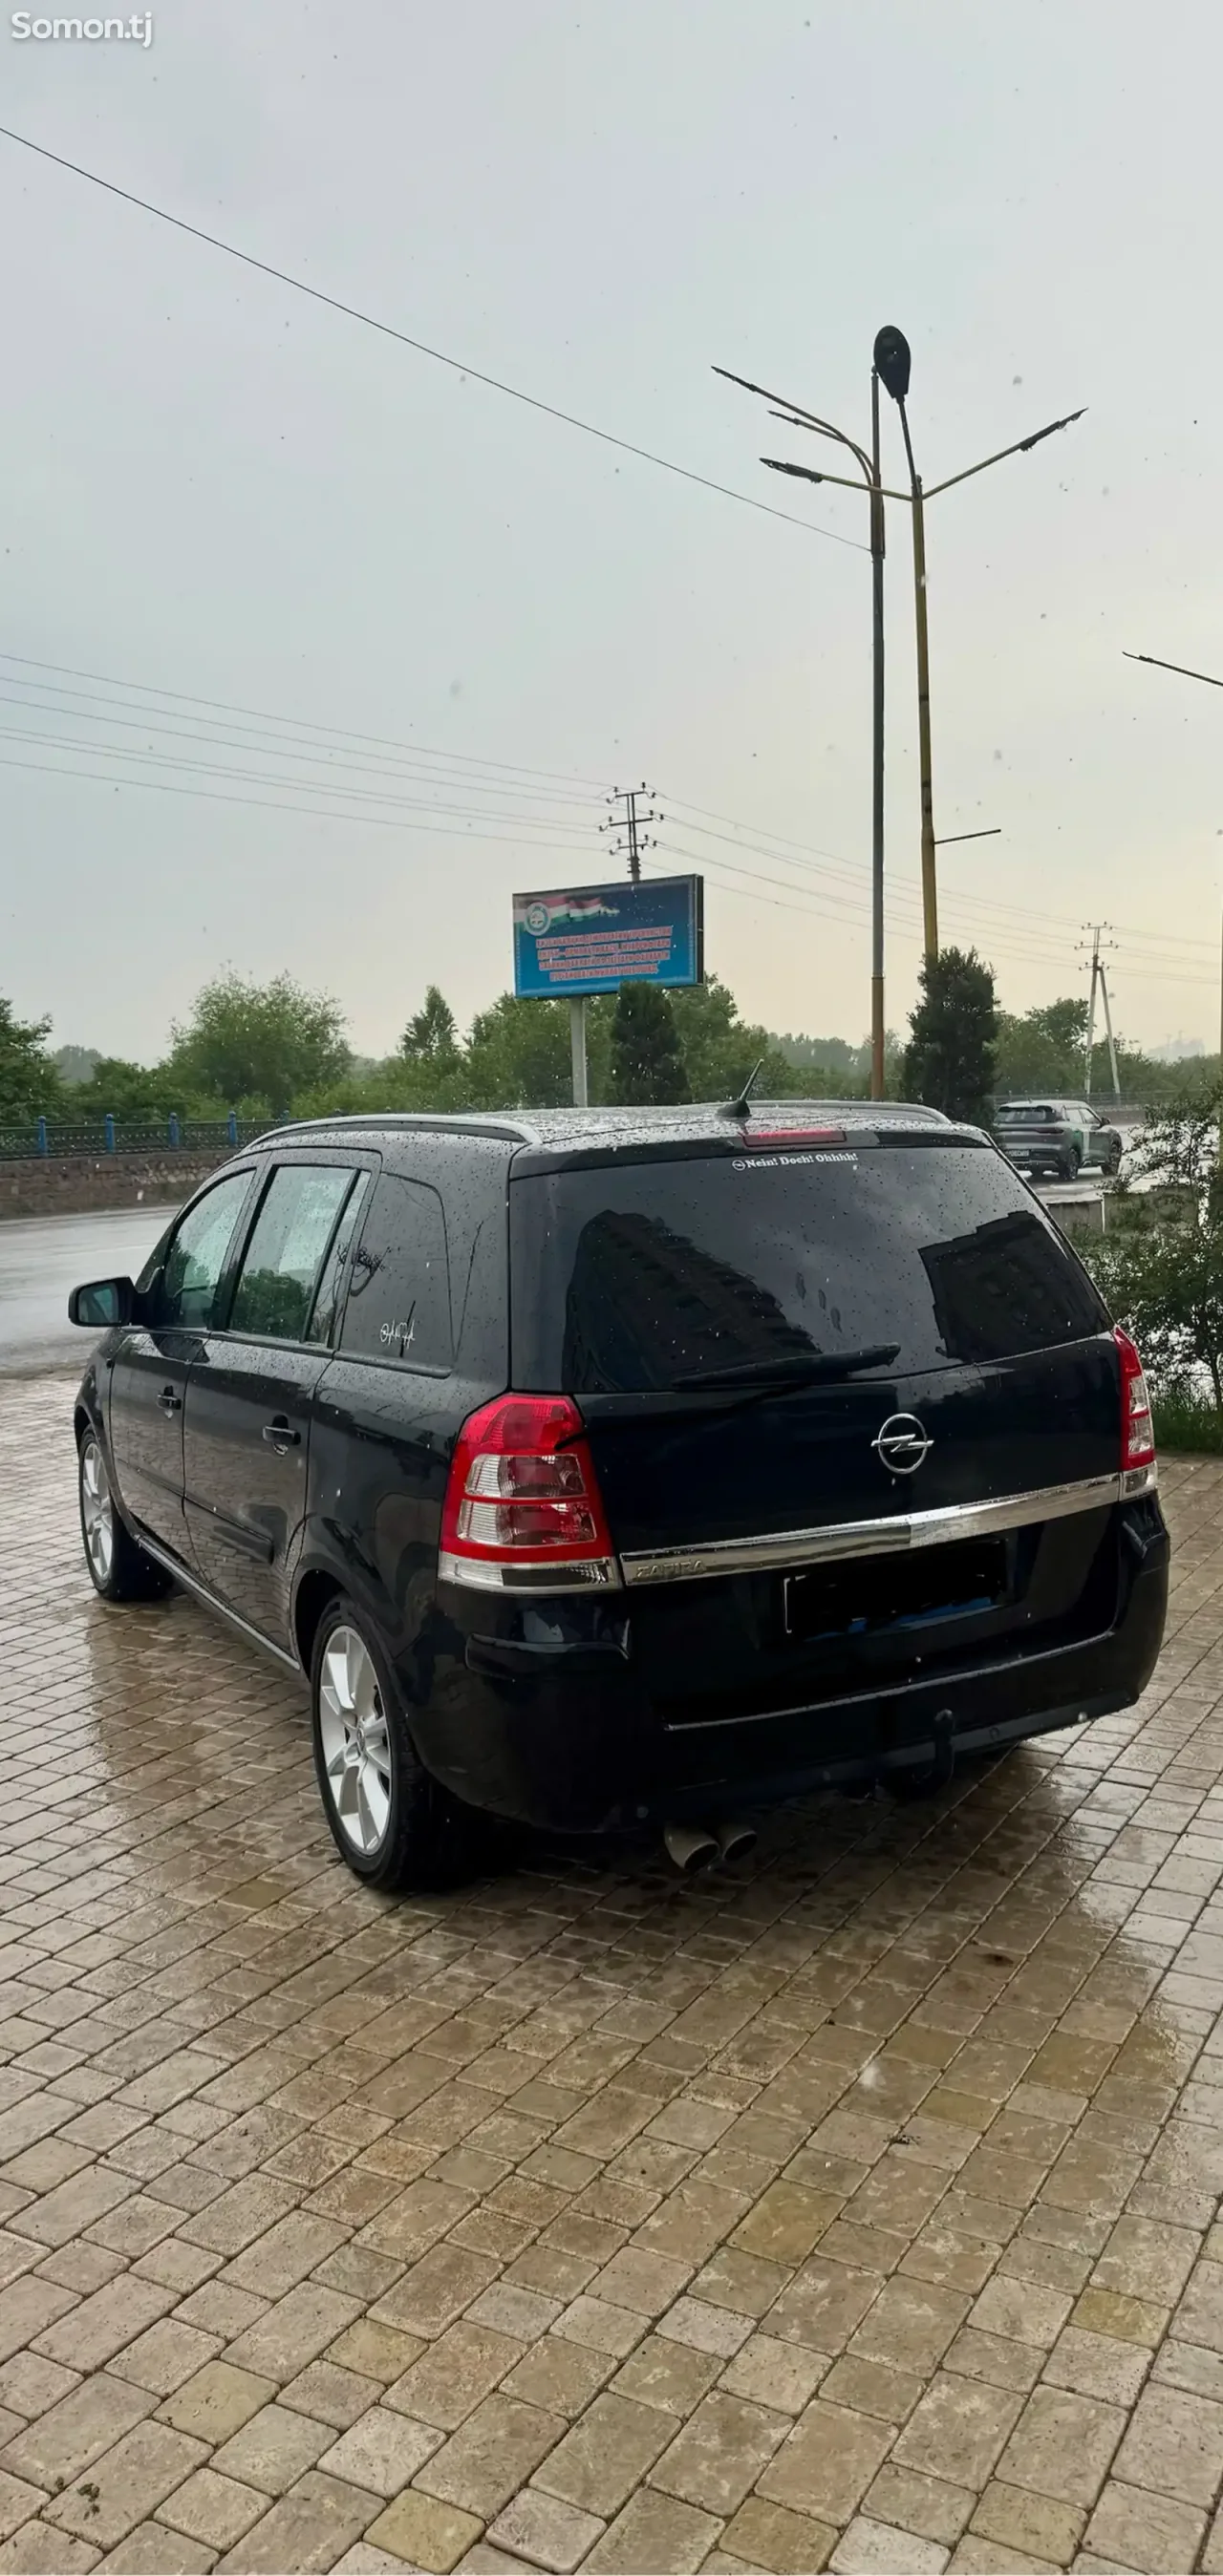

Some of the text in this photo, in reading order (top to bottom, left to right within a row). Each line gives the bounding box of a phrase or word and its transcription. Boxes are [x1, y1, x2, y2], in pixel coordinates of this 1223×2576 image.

[745, 1153, 859, 1168] Nein! Doch! Ohhhh!
